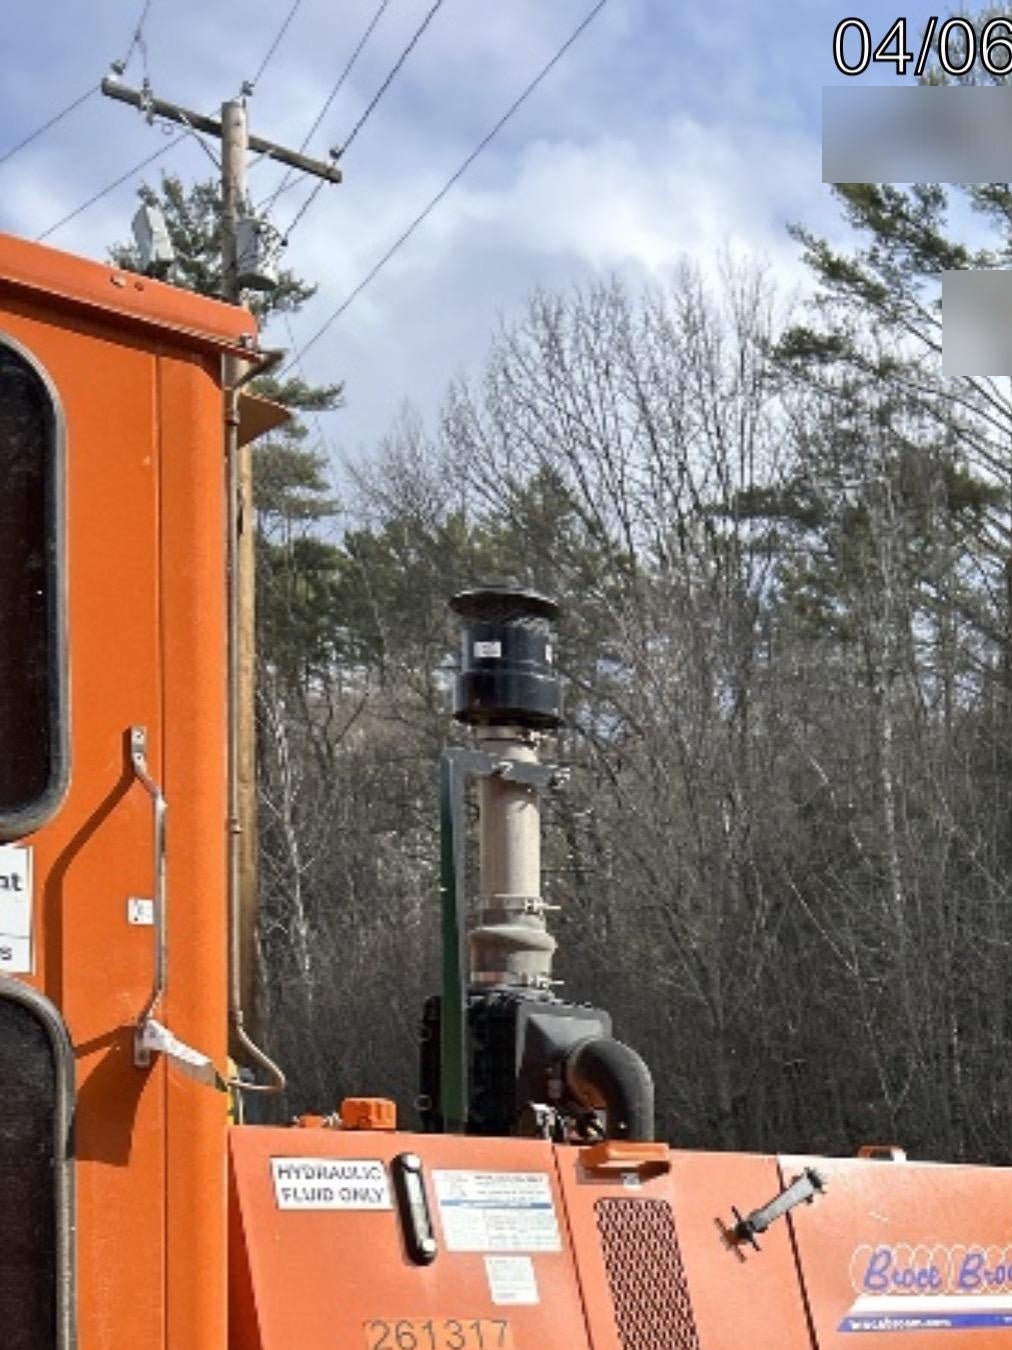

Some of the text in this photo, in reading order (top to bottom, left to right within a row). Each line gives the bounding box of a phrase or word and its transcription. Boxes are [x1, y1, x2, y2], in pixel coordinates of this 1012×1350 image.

[277, 1164, 382, 1181] HYDRAULIC
[281, 1187, 385, 1203] FLUID ONLY
